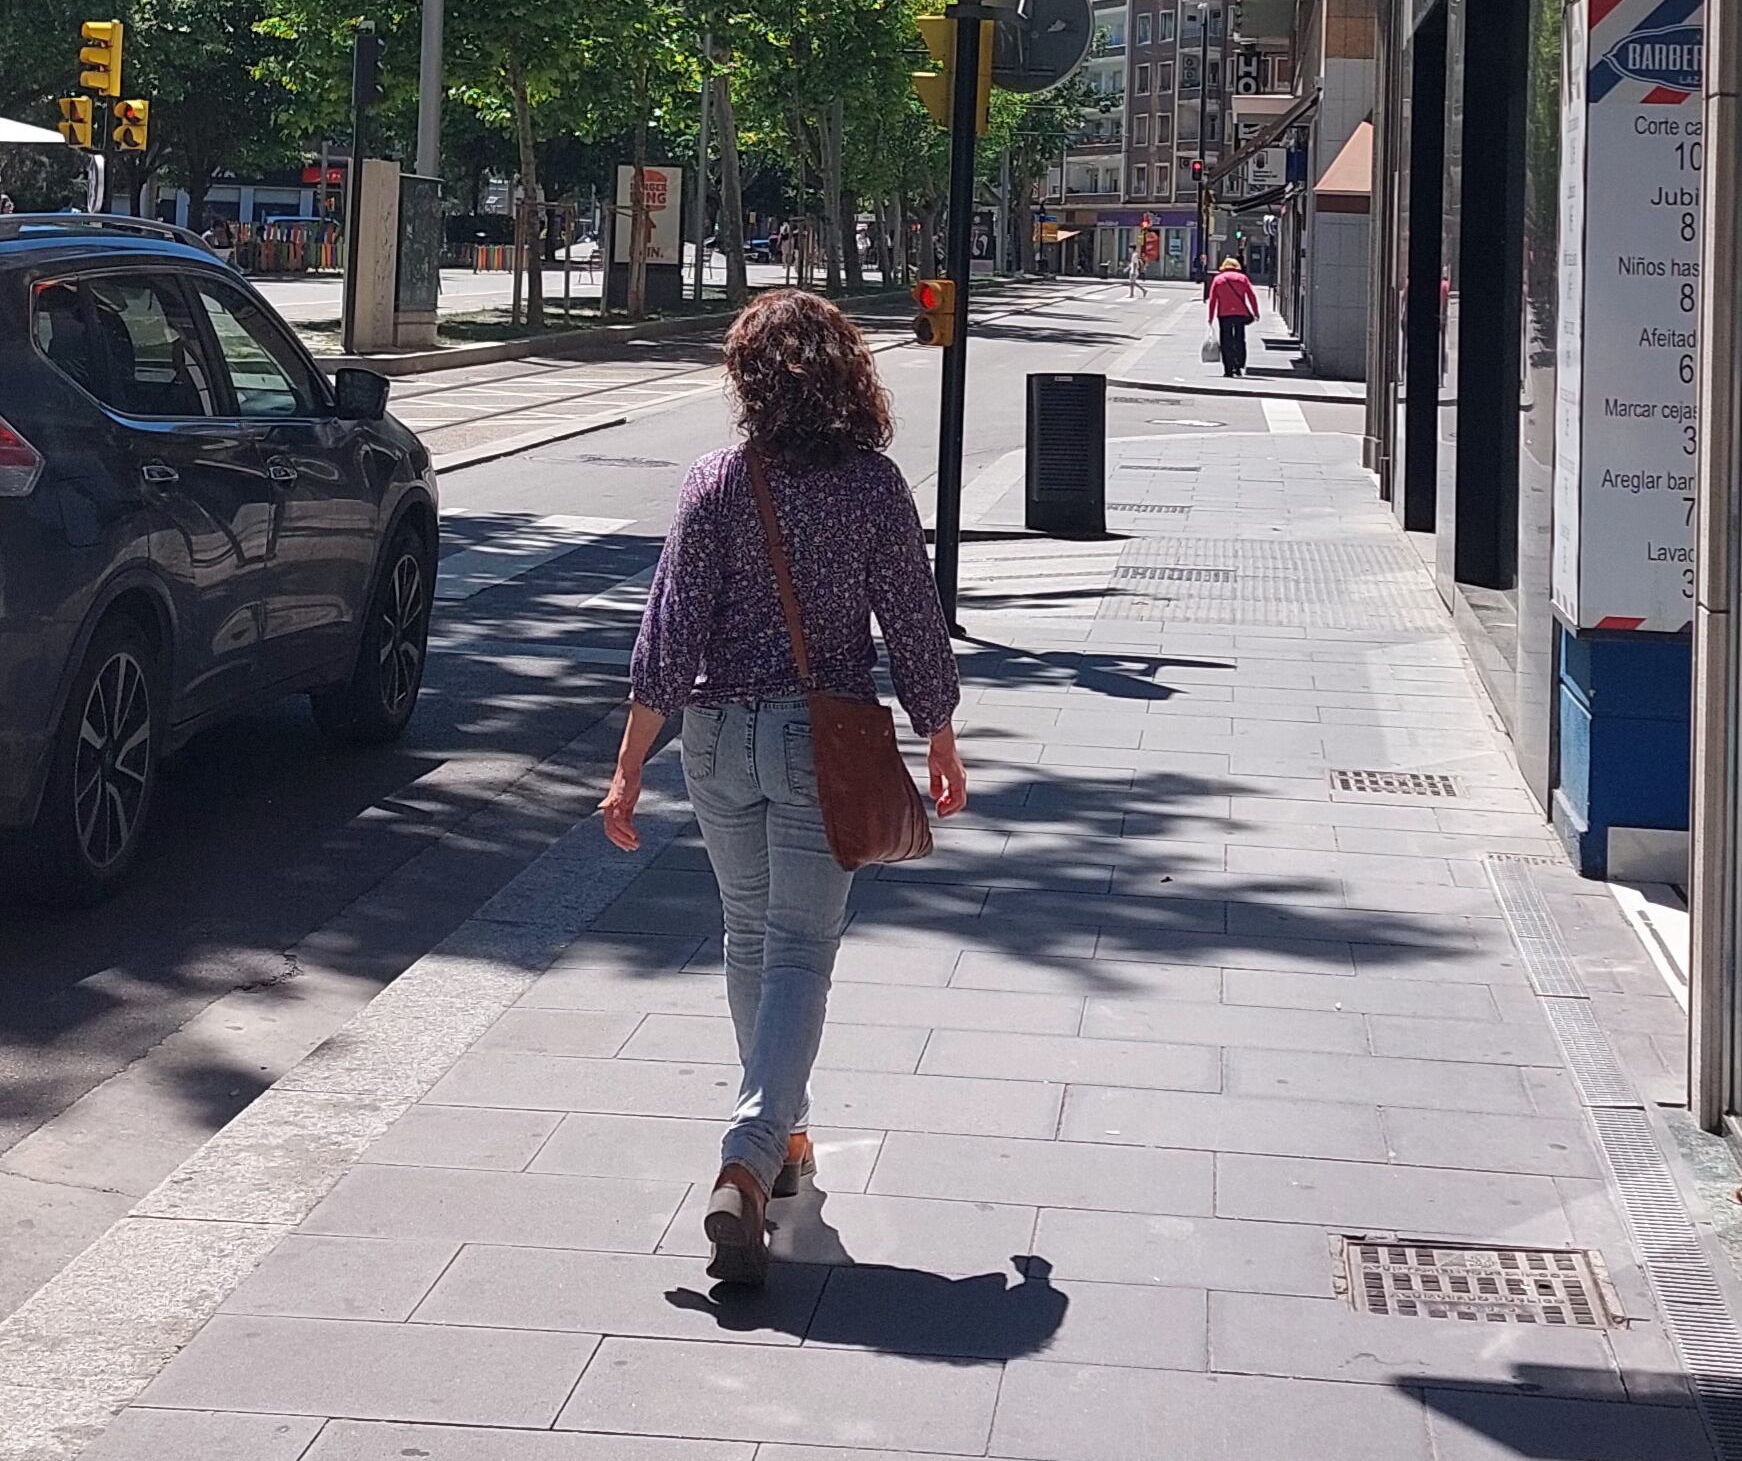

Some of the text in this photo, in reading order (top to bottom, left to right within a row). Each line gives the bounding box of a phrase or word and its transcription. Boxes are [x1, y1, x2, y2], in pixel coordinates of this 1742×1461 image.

[1634, 116, 1679, 135] Corte
[1675, 141, 1702, 171] 10
[1650, 187, 1699, 206] Jubi
[1681, 212, 1695, 241] 8
[1618, 256, 1700, 278] Niños has
[1680, 283, 1694, 312] 8
[1639, 328, 1696, 348] Afeitad
[1680, 354, 1694, 383] 6
[1605, 398, 1657, 418] Marcar
[1683, 426, 1697, 455] 3
[1601, 469, 1695, 493] Areglar bar
[1682, 497, 1695, 526] 7
